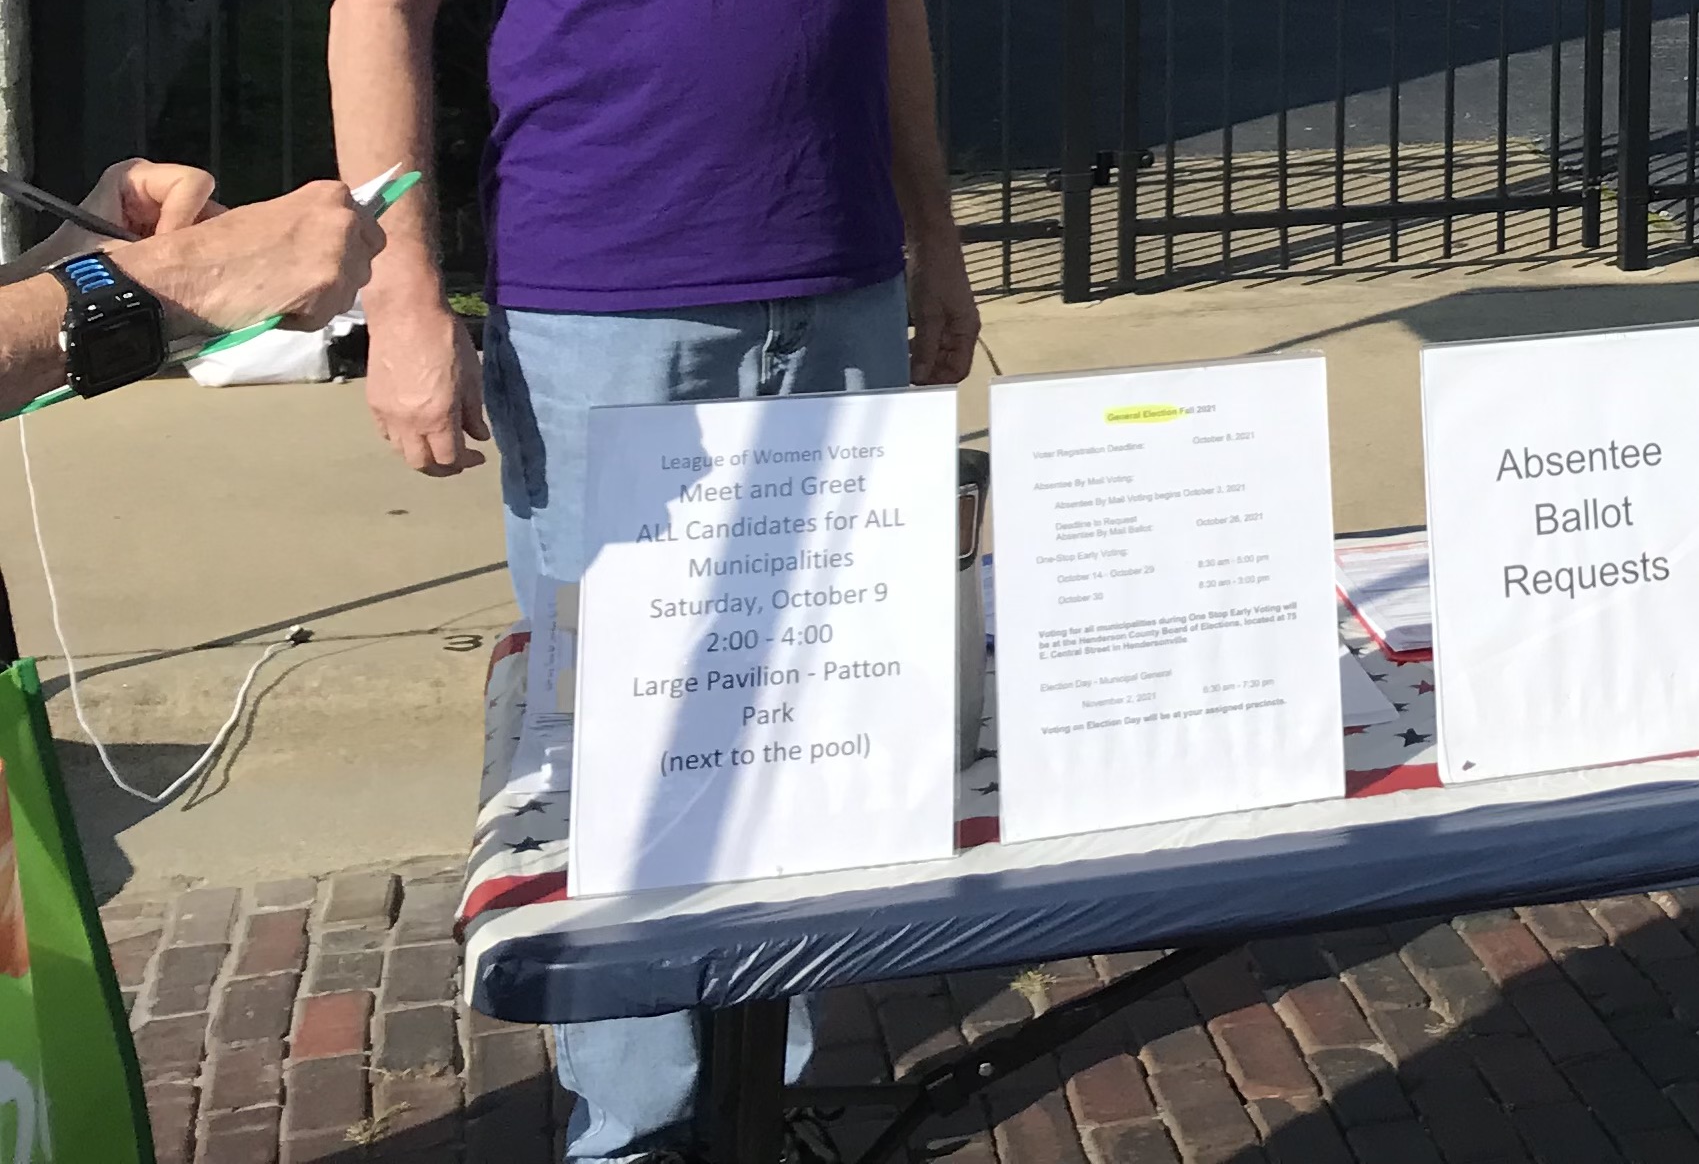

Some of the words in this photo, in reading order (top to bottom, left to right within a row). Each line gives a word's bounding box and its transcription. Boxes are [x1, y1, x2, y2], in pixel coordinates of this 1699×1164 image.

[661, 455, 725, 471] League
[729, 450, 749, 466] of
[753, 450, 822, 464] Women
[827, 445, 885, 460] Voters
[1496, 439, 1662, 482] Absentee
[680, 483, 743, 503] Meet
[750, 477, 793, 499] and
[801, 475, 866, 495] Greet
[636, 523, 679, 543] ALL
[686, 516, 817, 540] Candidates
[824, 511, 859, 531] for
[864, 508, 906, 528] ALL
[1535, 494, 1634, 537] Ballot
[689, 550, 854, 577] Municipalities
[1504, 551, 1670, 600] Requests
[650, 593, 763, 618] Saturday,
[772, 586, 868, 609] October
[874, 582, 888, 602] 9
[706, 629, 759, 652] 2:00
[781, 624, 833, 645] 4:00
[633, 677, 699, 699] Large
[707, 666, 800, 690] Pavilion
[824, 661, 901, 680] Patton
[743, 702, 794, 725] Park
[661, 749, 724, 777] (next
[730, 748, 755, 766] to
[763, 741, 802, 763] the
[810, 733, 870, 763] pool)
